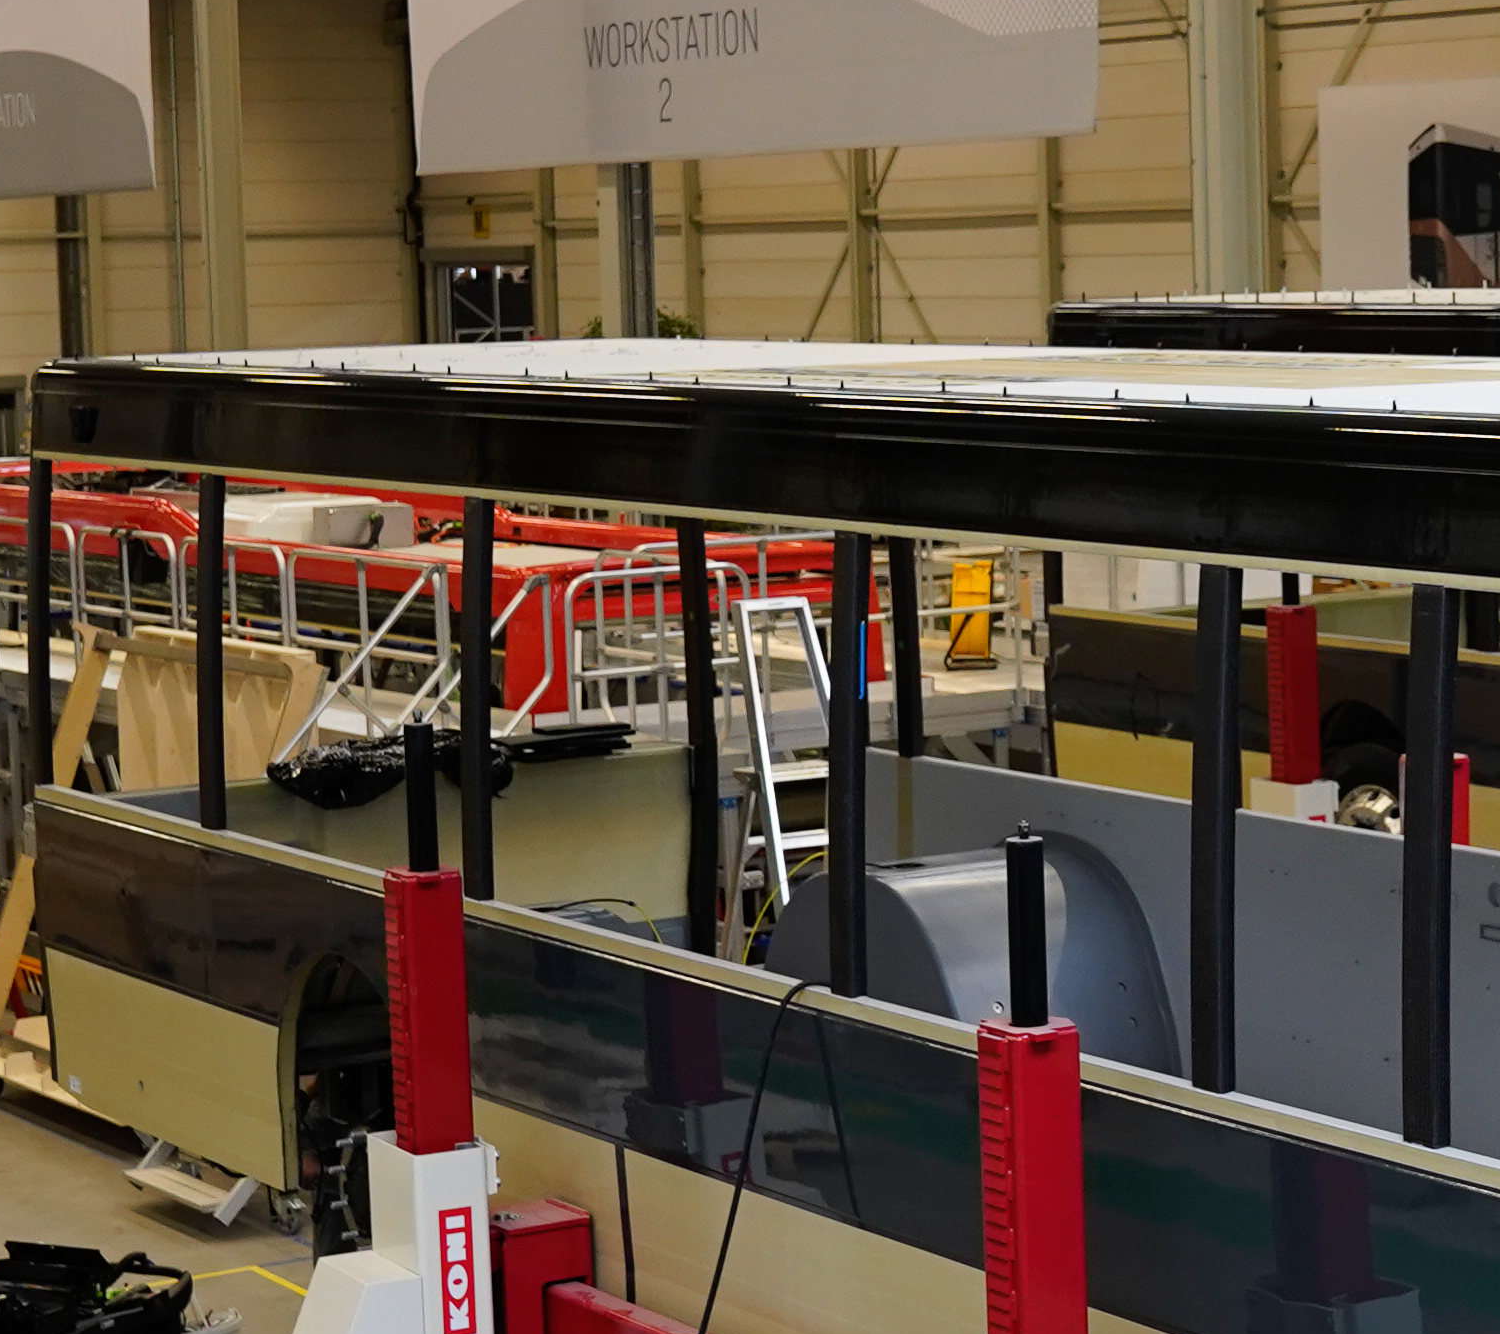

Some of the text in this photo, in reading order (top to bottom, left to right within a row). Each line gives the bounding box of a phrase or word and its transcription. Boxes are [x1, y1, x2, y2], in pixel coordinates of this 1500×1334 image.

[583, 6, 760, 68] WORKSTATION
[658, 77, 673, 123] 2
[444, 1213, 471, 1332] KONI
